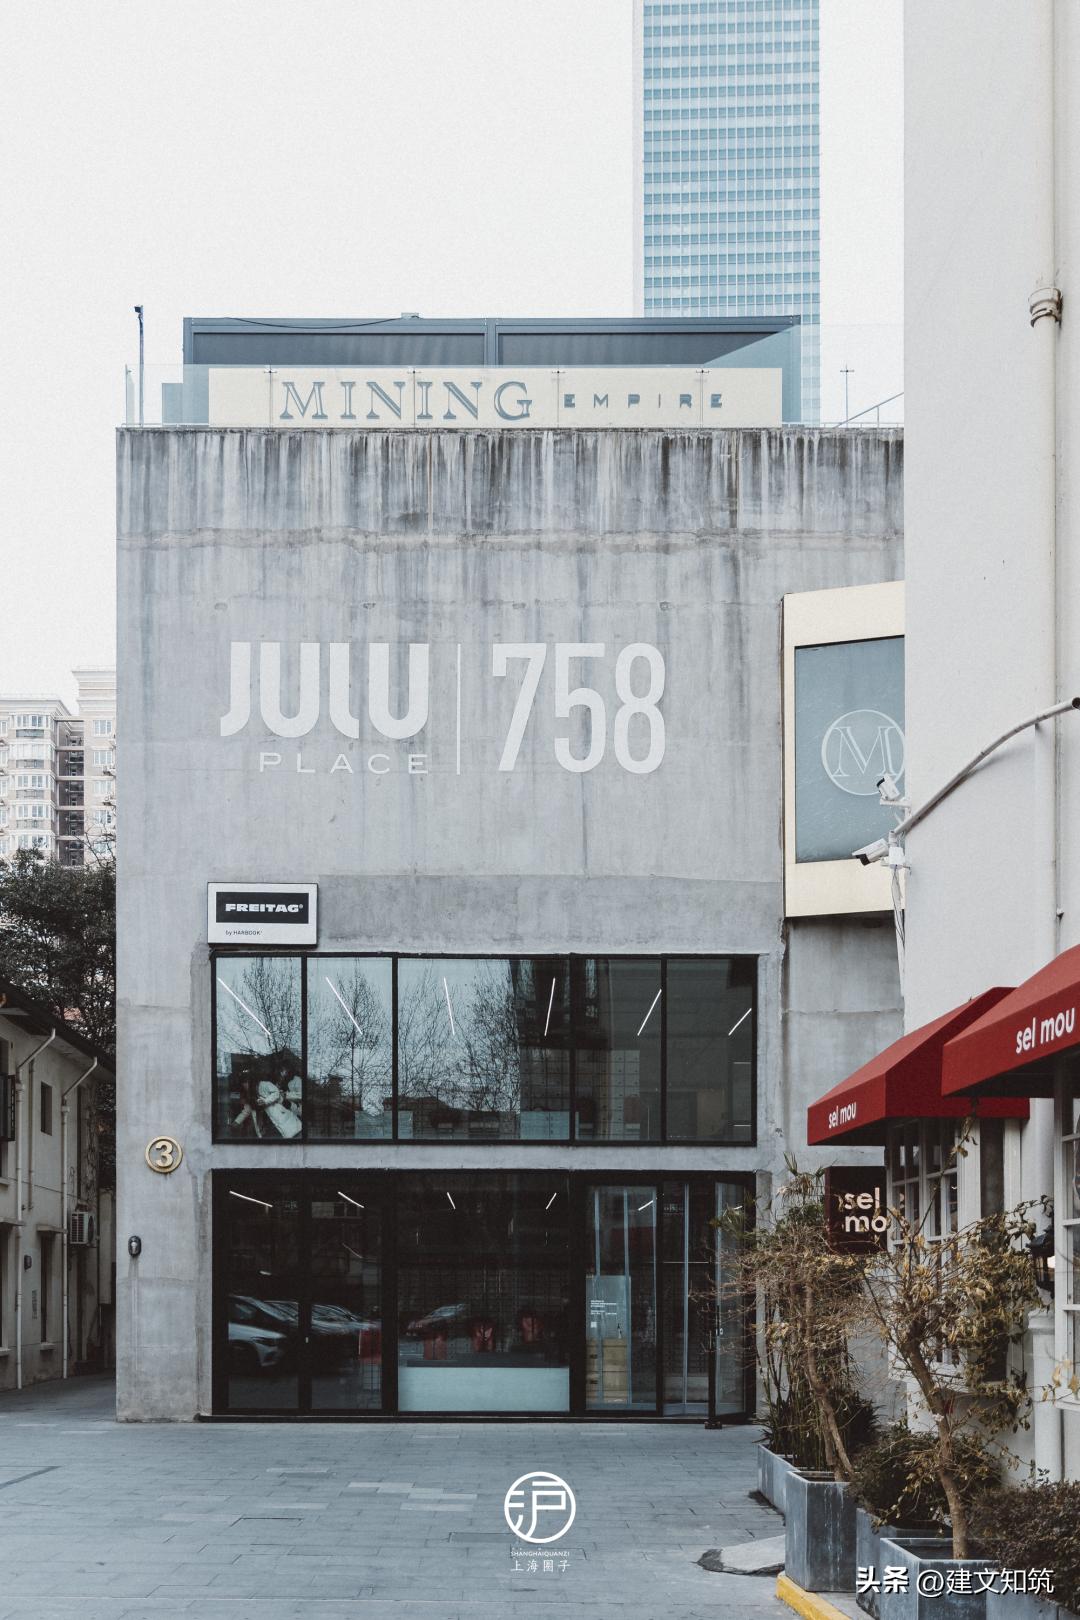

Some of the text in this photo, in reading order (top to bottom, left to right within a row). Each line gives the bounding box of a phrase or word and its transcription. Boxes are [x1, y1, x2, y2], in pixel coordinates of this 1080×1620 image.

[279, 381, 723, 421] MINING EMPIRE
[220, 641, 430, 740] JULU
[492, 642, 666, 774] 758
[259, 752, 429, 775] PLACE
[832, 726, 900, 777] M
[1015, 1008, 1075, 1054] sel mou
[828, 1102, 856, 1129] sel mou
[155, 1140, 174, 1168] 3
[844, 1187, 880, 1210] sel
[845, 1215, 887, 1232] mo
